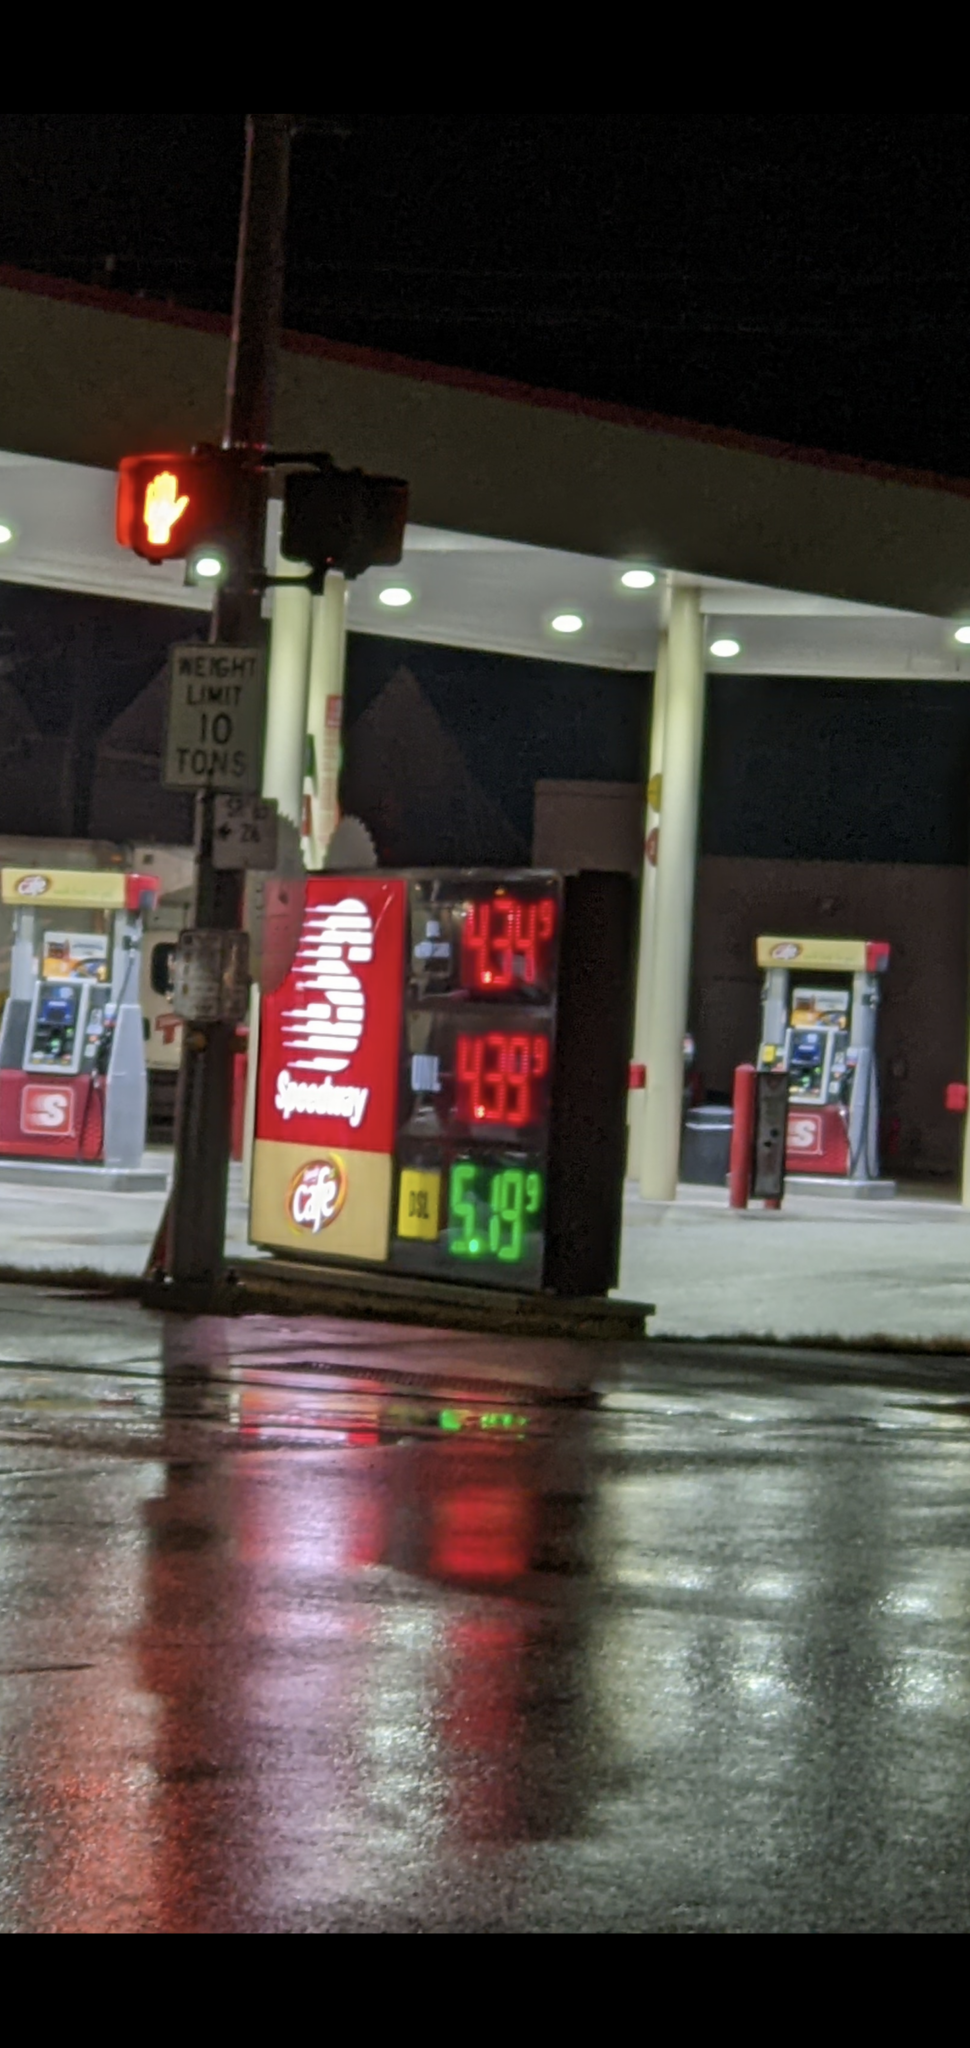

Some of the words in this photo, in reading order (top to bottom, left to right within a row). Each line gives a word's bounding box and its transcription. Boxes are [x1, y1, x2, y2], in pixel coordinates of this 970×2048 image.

[178, 656, 258, 678] WEIGHT
[187, 685, 243, 706] LIMIT
[201, 713, 233, 745] 10
[177, 748, 246, 775] TONS
[275, 1069, 369, 1128] Speedway
[408, 1190, 430, 1219] DSL
